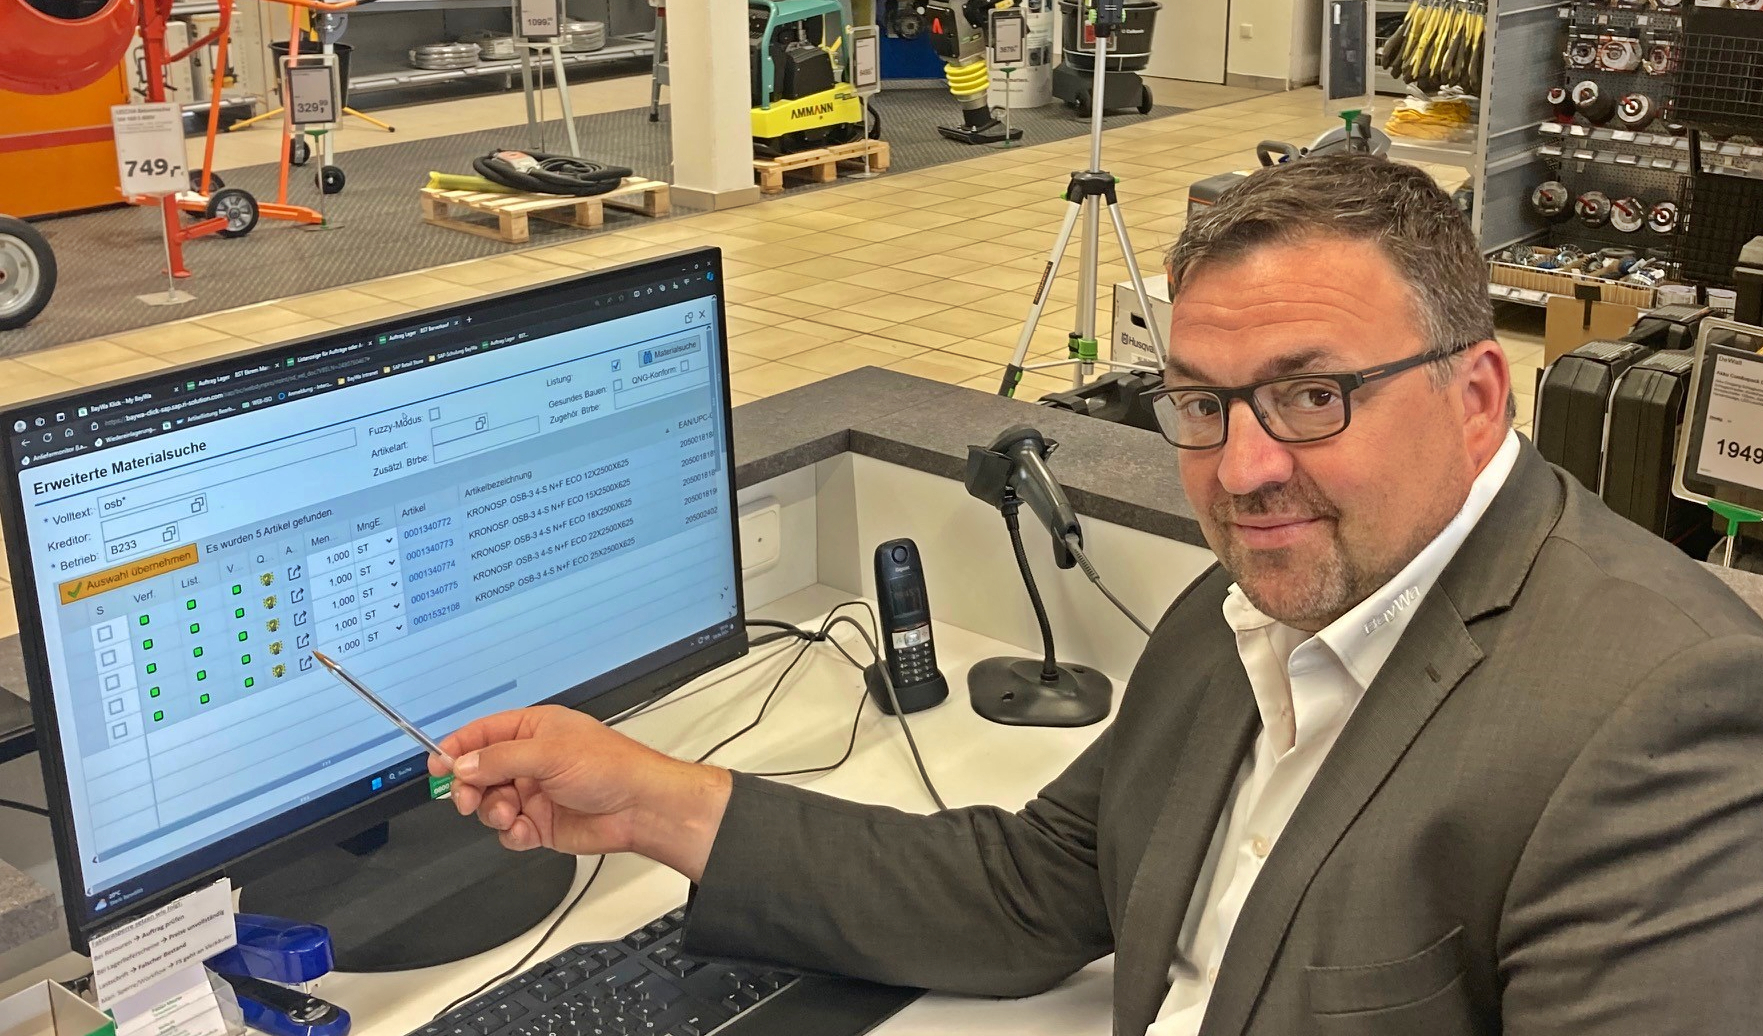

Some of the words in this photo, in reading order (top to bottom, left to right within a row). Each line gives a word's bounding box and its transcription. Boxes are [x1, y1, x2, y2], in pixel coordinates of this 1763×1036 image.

[791, 102, 834, 119] AMMANN
[654, 341, 696, 359] Materialsuche
[549, 392, 582, 408] Gesundes
[33, 467, 108, 496] Erweiterte
[112, 441, 207, 475] Materialsuche
[464, 470, 533, 498] Artikelbezeichnung
[52, 507, 94, 526] Volltext:
[357, 543, 369, 554] ST
[404, 516, 452, 539] 0001340772
[466, 498, 507, 519] KRONOSP
[510, 489, 534, 504] OSB-3
[535, 485, 548, 496] 4-S
[549, 480, 564, 491] N+F
[565, 475, 582, 486] ECO
[584, 458, 629, 480] 12X2500X625
[401, 503, 426, 517] Artikel
[47, 533, 91, 552] Kreditor:
[206, 543, 218, 554] Es
[220, 532, 253, 549] wurden
[256, 529, 262, 538] 5
[263, 520, 291, 536] Artikel
[360, 565, 372, 577] ST
[406, 538, 454, 561] 0001340773
[468, 519, 509, 540] KRONOSP
[512, 510, 536, 525] OSB-3
[537, 506, 550, 517] 4-S
[551, 500, 566, 512] N+F
[567, 494, 584, 507] ECO
[585, 478, 631, 500] 15X2500X625
[111, 539, 137, 555] B233
[362, 587, 374, 599] ST
[408, 559, 456, 583] 0001340774
[470, 540, 511, 561] KRONOSP
[514, 531, 538, 546] OSB-3
[539, 526, 552, 537] 4-S
[553, 521, 567, 532] N+F
[569, 515, 586, 527] ECO
[587, 498, 633, 520] 18X2500X625
[365, 609, 376, 621] ST
[411, 582, 459, 604] 0001340775
[473, 561, 514, 582] KRONOSP
[516, 552, 540, 566] OSB-3
[541, 546, 554, 557] 4-S
[554, 540, 569, 552] N+F
[571, 535, 587, 547] ECO
[589, 517, 634, 540] 22X2500X625
[684, 487, 718, 506] 205001819
[86, 569, 130, 591] Auswahl
[131, 552, 191, 576] übernehmen
[368, 631, 379, 643] ST
[413, 602, 461, 626] 0001532108
[475, 582, 515, 603] KRONOSP
[517, 572, 541, 587] OSB-3
[542, 566, 555, 578] 4-S
[556, 561, 571, 572] N+F
[572, 555, 589, 567] ECO
[590, 537, 636, 560] 25X2500X625
[96, 605, 104, 615] S
[1364, 586, 1420, 634] BayWa
[104, 940, 133, 956] Retouren
[141, 924, 164, 939] Auftrag
[165, 914, 185, 928] prüfen
[106, 941, 160, 970] Lagerlieferscheine
[168, 928, 186, 940] Preise
[187, 910, 224, 931] unvollständig
[138, 954, 162, 970] Falscher
[163, 942, 187, 957] Bestand
